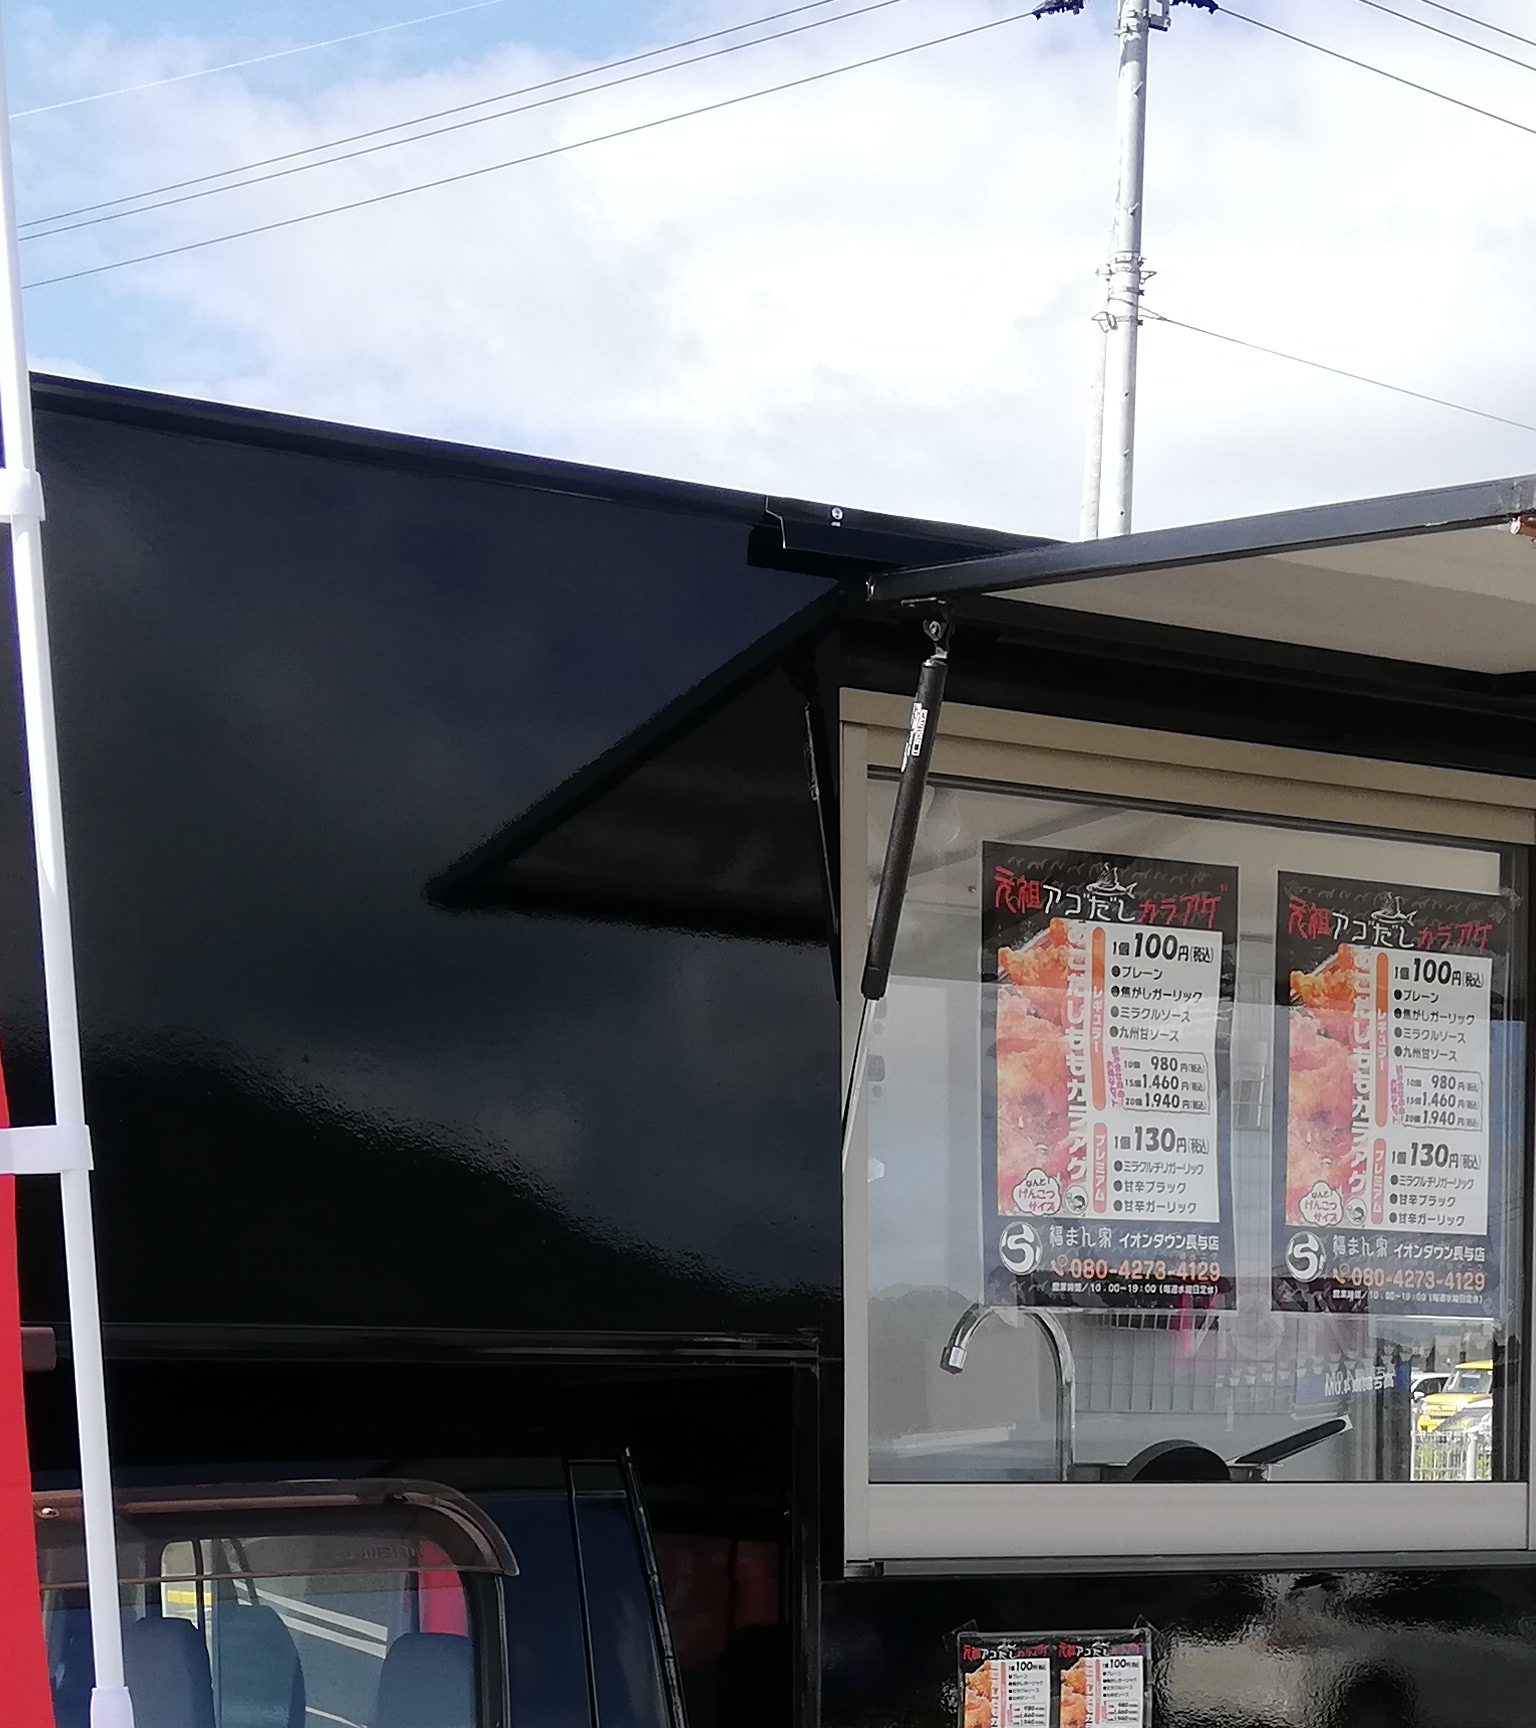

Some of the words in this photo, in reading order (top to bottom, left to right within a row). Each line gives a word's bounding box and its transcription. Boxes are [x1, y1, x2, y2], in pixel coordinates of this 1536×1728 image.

[1121, 967, 1163, 980] プレーン
[1120, 986, 1203, 1003] 焦がしガーリック
[1403, 990, 1439, 1003] プレーン
[1119, 1006, 1191, 1022] ミラクルソース
[1402, 1008, 1475, 1026] 焦がしガーリック
[1118, 1026, 1179, 1042] 九州甘ソース
[1403, 1028, 1466, 1043] ミラクルソース
[1403, 1046, 1457, 1062] 九州甘ソース
[1124, 1180, 1186, 1194] 甘辛ブラック
[1124, 1200, 1197, 1214] 甘辛ガーリック
[1399, 1194, 1456, 1207] 甘辛ブラック
[1398, 1212, 1465, 1226] 甘辛ガーリック
[1049, 1224, 1113, 1248] 福まん家
[1333, 1234, 1388, 1256] 福まん家
[1070, 1258, 1221, 1282] 080-4273-4129
[1352, 1266, 1486, 1290] 080-4273-4129
